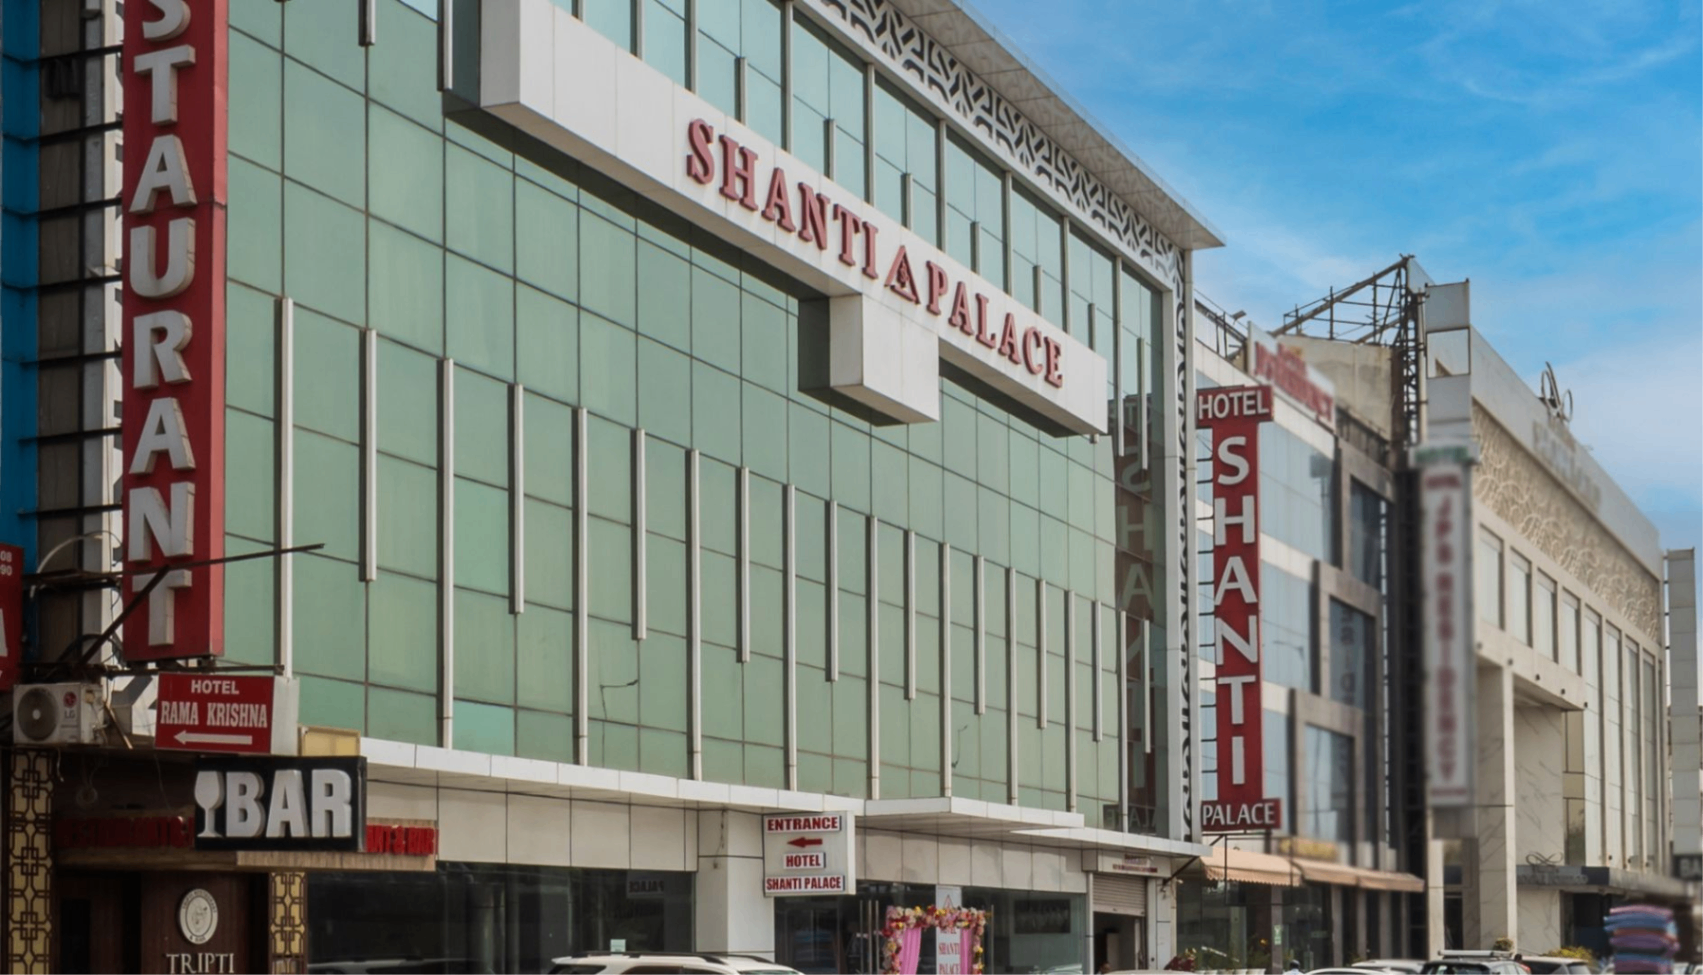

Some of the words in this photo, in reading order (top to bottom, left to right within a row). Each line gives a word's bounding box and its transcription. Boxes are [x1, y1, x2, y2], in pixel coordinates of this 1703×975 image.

[686, 118, 879, 280] SHANTI
[926, 260, 1063, 389] PALACE
[1198, 389, 1270, 420] HOTEL
[1213, 436, 1259, 785] SHANTI
[190, 679, 240, 695] HOTEL
[160, 701, 199, 725] RAMA
[206, 702, 268, 728] KRISHNA
[225, 768, 353, 838] BAR
[1202, 802, 1275, 826] PALACE
[767, 816, 839, 832] ENTRANCE
[785, 854, 822, 868] HOTEL
[766, 877, 802, 891] SHANTI
[804, 876, 842, 890] PALACE
[166, 952, 235, 975] TRIPTI
